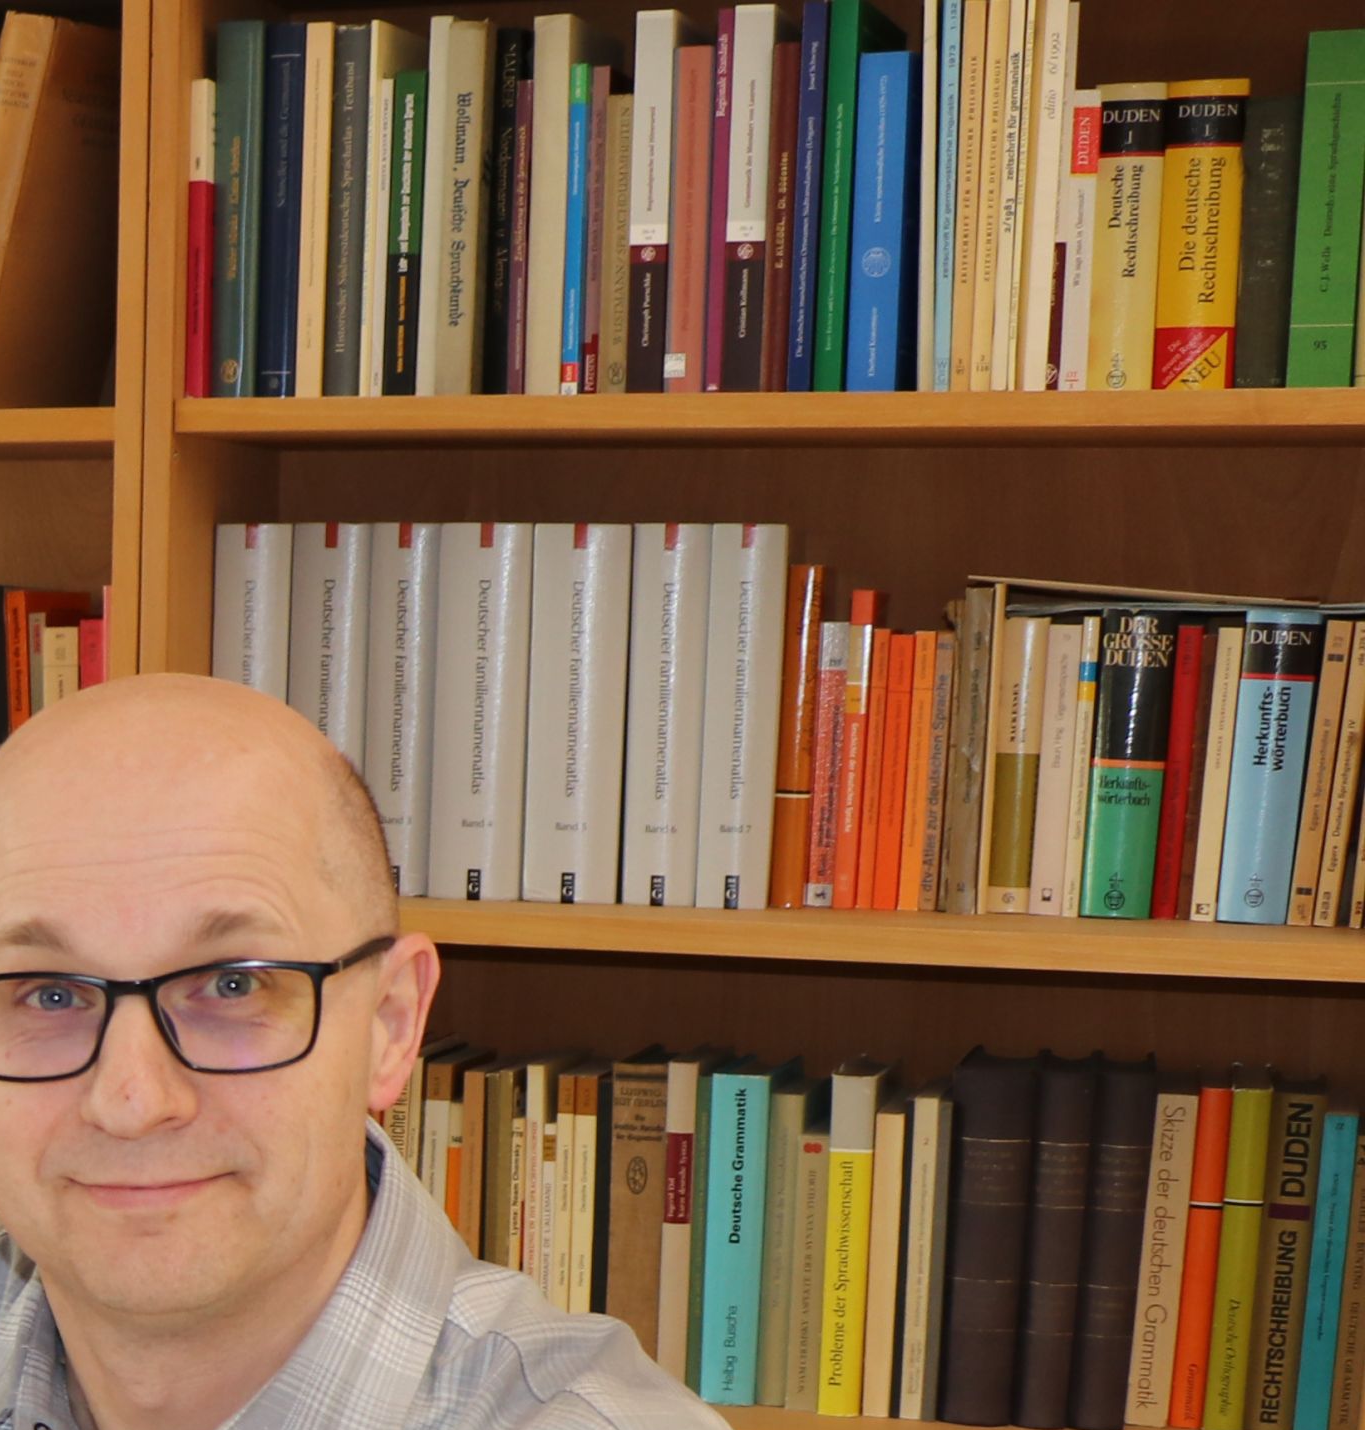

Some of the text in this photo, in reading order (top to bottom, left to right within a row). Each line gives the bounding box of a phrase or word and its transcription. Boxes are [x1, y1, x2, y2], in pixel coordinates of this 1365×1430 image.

[716, 33, 729, 117] Regionale Standards
[1047, 32, 1059, 75] 6/1992
[1005, 51, 1021, 180] zeitschrift für germanistik
[1077, 116, 1091, 166] DUDEN
[1103, 108, 1161, 123] DUDEN
[1178, 103, 1239, 118] DUDEN
[335, 61, 355, 352] Historischer Südwestdeutscher Sprachatlas Textband
[941, 94, 957, 279] zeitschrift germanistische linguistik
[961, 127, 973, 284] ZEITSCHRIFT DEUTSCHE
[1108, 165, 1125, 228] Deutsche
[1122, 165, 1145, 278] Rechtschreibung
[1179, 158, 1202, 272] Die deutsche
[1197, 157, 1227, 304] Rechtschreibung
[640, 272, 653, 346] Christoph Purschke
[738, 268, 750, 338] Cristian Kollmann
[242, 579, 258, 653] Deutscher
[320, 579, 336, 649] Deutscher
[1103, 632, 1174, 651] GROSSE
[1119, 615, 1157, 634] DER
[1250, 628, 1312, 646] DUDEN
[390, 579, 410, 792] Deutscher Familiennamenatlas
[471, 579, 492, 795] Deutscher Familiennamenatlas
[564, 580, 585, 798] Deutscher Familiennamenatlas
[655, 582, 674, 800] Deutscher Familiennamenatlas
[729, 580, 751, 800] Deutscher Familiennamenatlas
[1105, 649, 1167, 668] DUDEN
[1252, 686, 1274, 766] Herkunfts-
[1269, 686, 1292, 772] wörterbuch
[1313, 730, 1329, 797] Sprachgeschichte
[920, 674, 949, 893] dtv-Atlas zur deutschen Sprache
[1330, 731, 1355, 837] Deutsche Sprachgeschichte
[645, 824, 667, 834] Band
[720, 824, 741, 834] Band
[512, 1144, 521, 1207] Noam Chomsky
[542, 1183, 552, 1248] DE L'ALLEMAND
[721, 1087, 746, 1391] Helbig Buscha Deutsche Grammatik
[827, 1160, 854, 1387] Probleme der Sprachwissenschaft
[1135, 1104, 1186, 1409] Skizze der deutschen Grammatik
[1259, 1102, 1314, 1425] RECHTSCHREIBUNG DUDEN
[1224, 1298, 1242, 1346] Deutsche
[1338, 1301, 1361, 1425] DEUTSCHE GRAMMATIK
[1183, 1363, 1199, 1422] Grammatik
